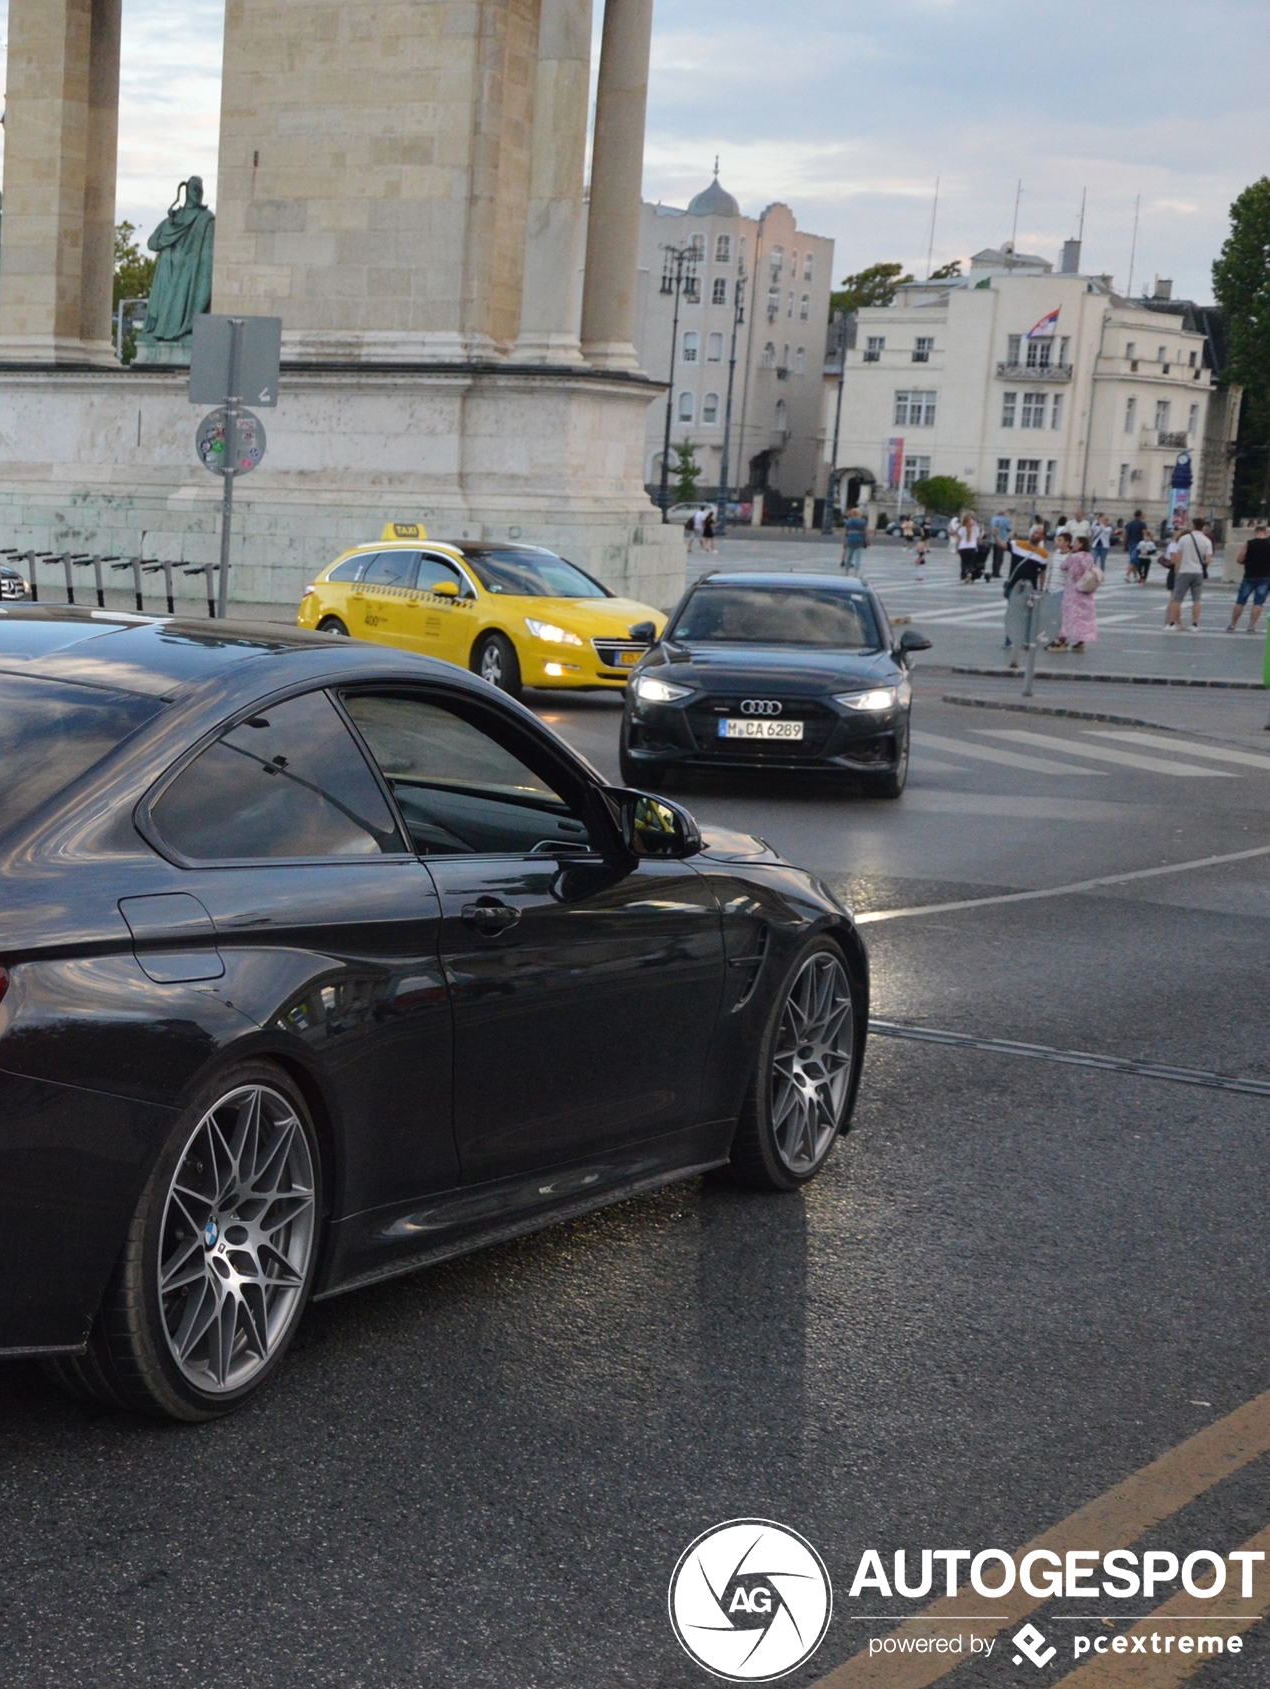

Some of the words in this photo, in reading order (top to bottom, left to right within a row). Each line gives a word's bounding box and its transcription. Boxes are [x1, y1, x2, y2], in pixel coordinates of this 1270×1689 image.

[397, 525, 417, 534] TAXI
[727, 722, 737, 735] M
[746, 722, 764, 735] CA
[767, 723, 802, 737] 6289
